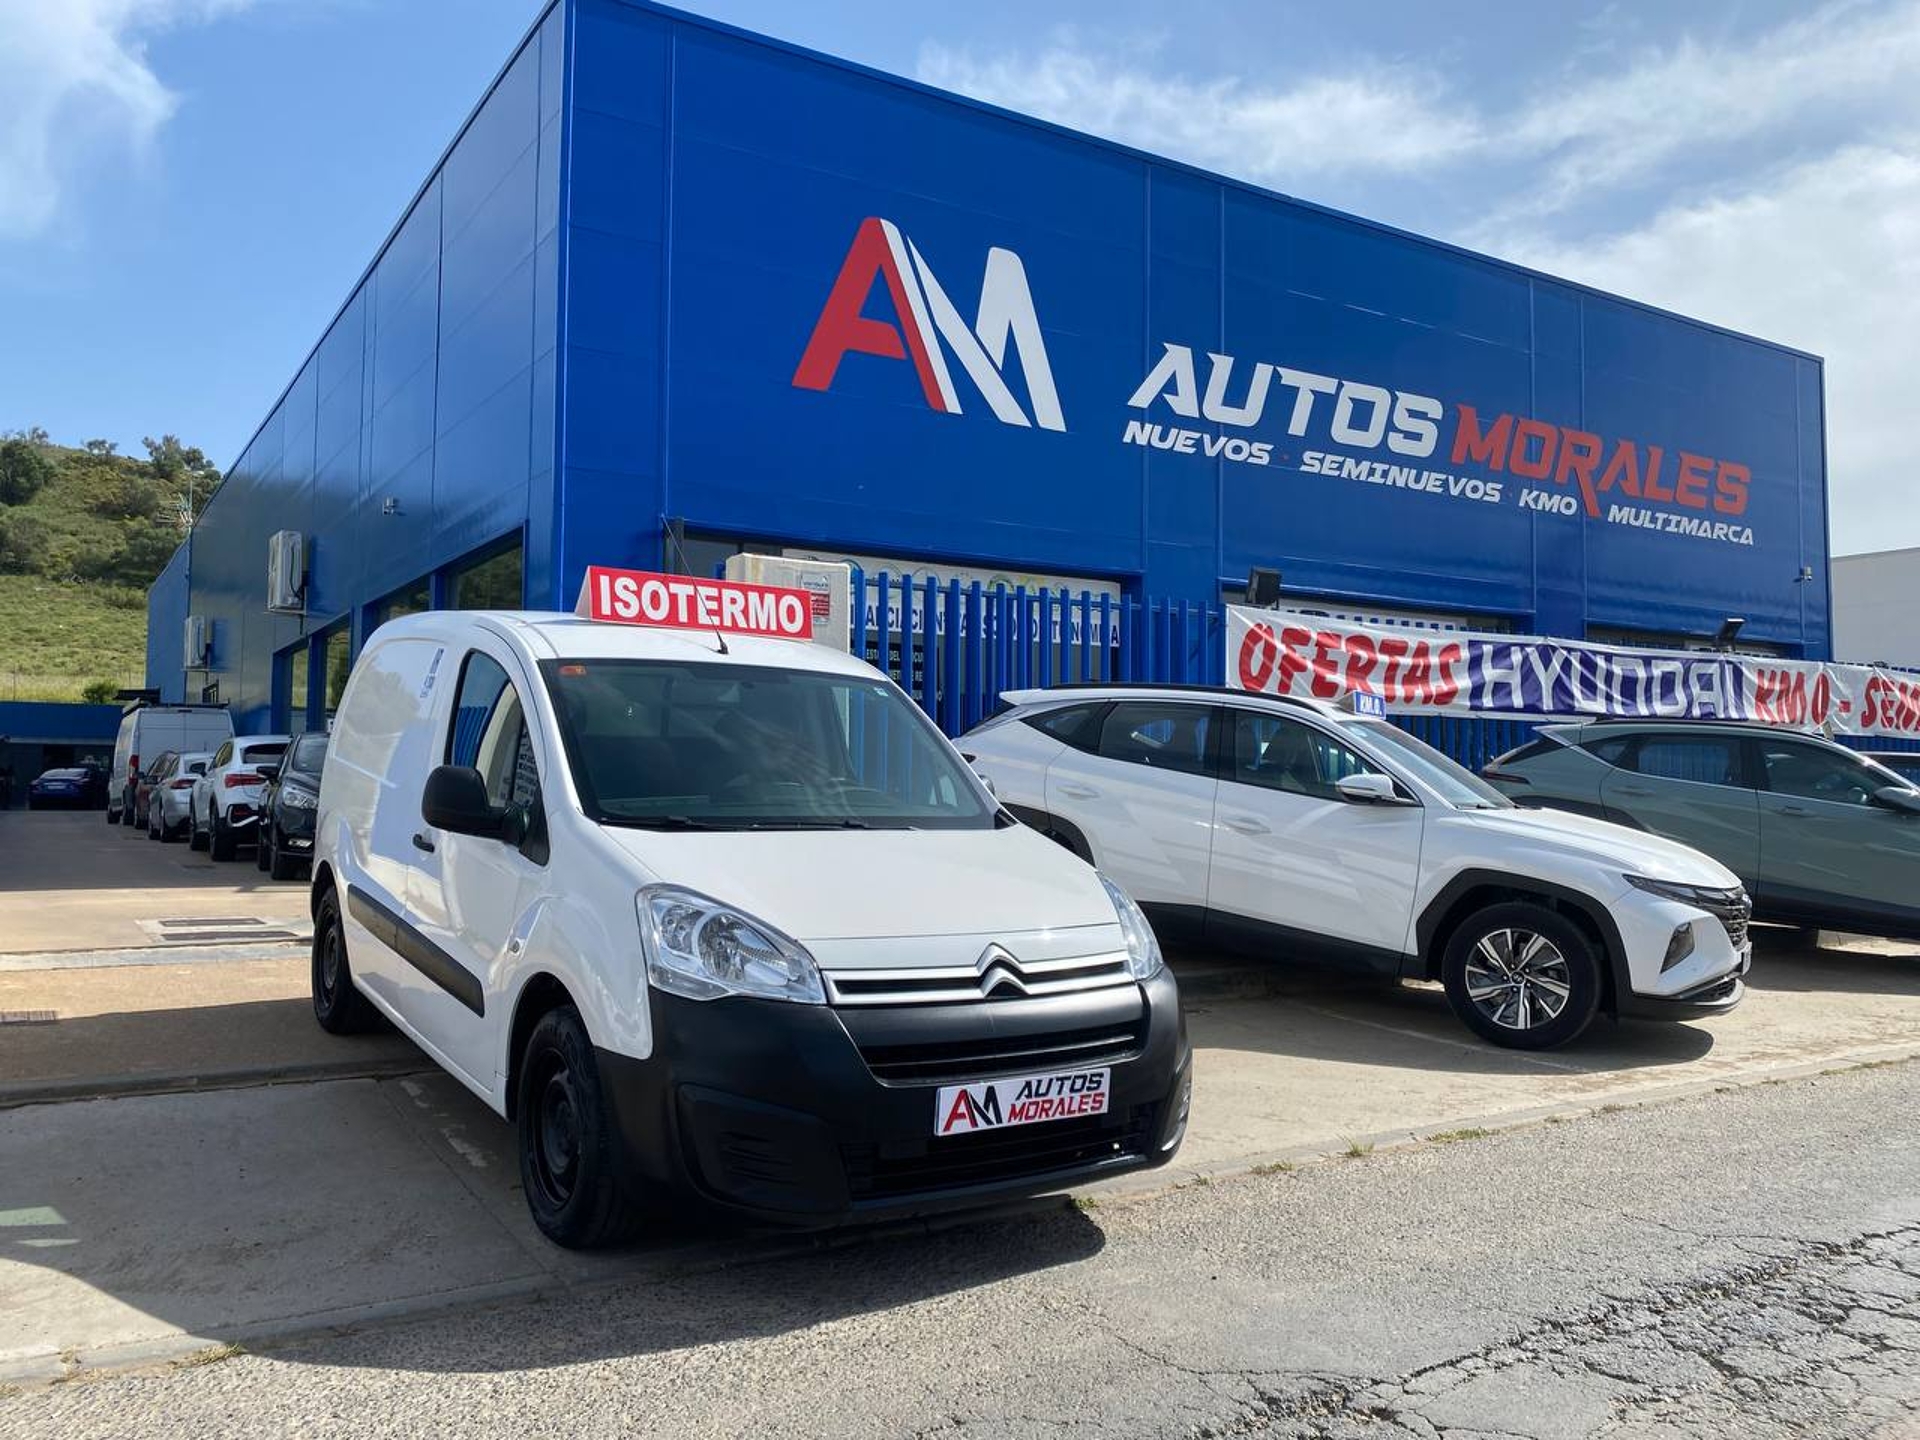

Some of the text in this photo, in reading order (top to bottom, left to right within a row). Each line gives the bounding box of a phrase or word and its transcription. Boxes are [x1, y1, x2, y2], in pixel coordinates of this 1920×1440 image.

[791, 216, 1067, 432] AM
[1127, 342, 1752, 518] AUTOS MORALES
[1122, 420, 1274, 466] NUEVOS
[1300, 450, 1503, 503] SEMINUEVOS
[1608, 504, 1754, 546] MULTIMARCA
[599, 575, 804, 634] ISOTERMO
[1238, 622, 1462, 706] OFERTAS
[1481, 644, 1740, 719] HYUNDAI
[943, 1085, 1003, 1132] AM
[1008, 1092, 1105, 1123] MORALES
[1015, 1073, 1104, 1101] AUTOS
